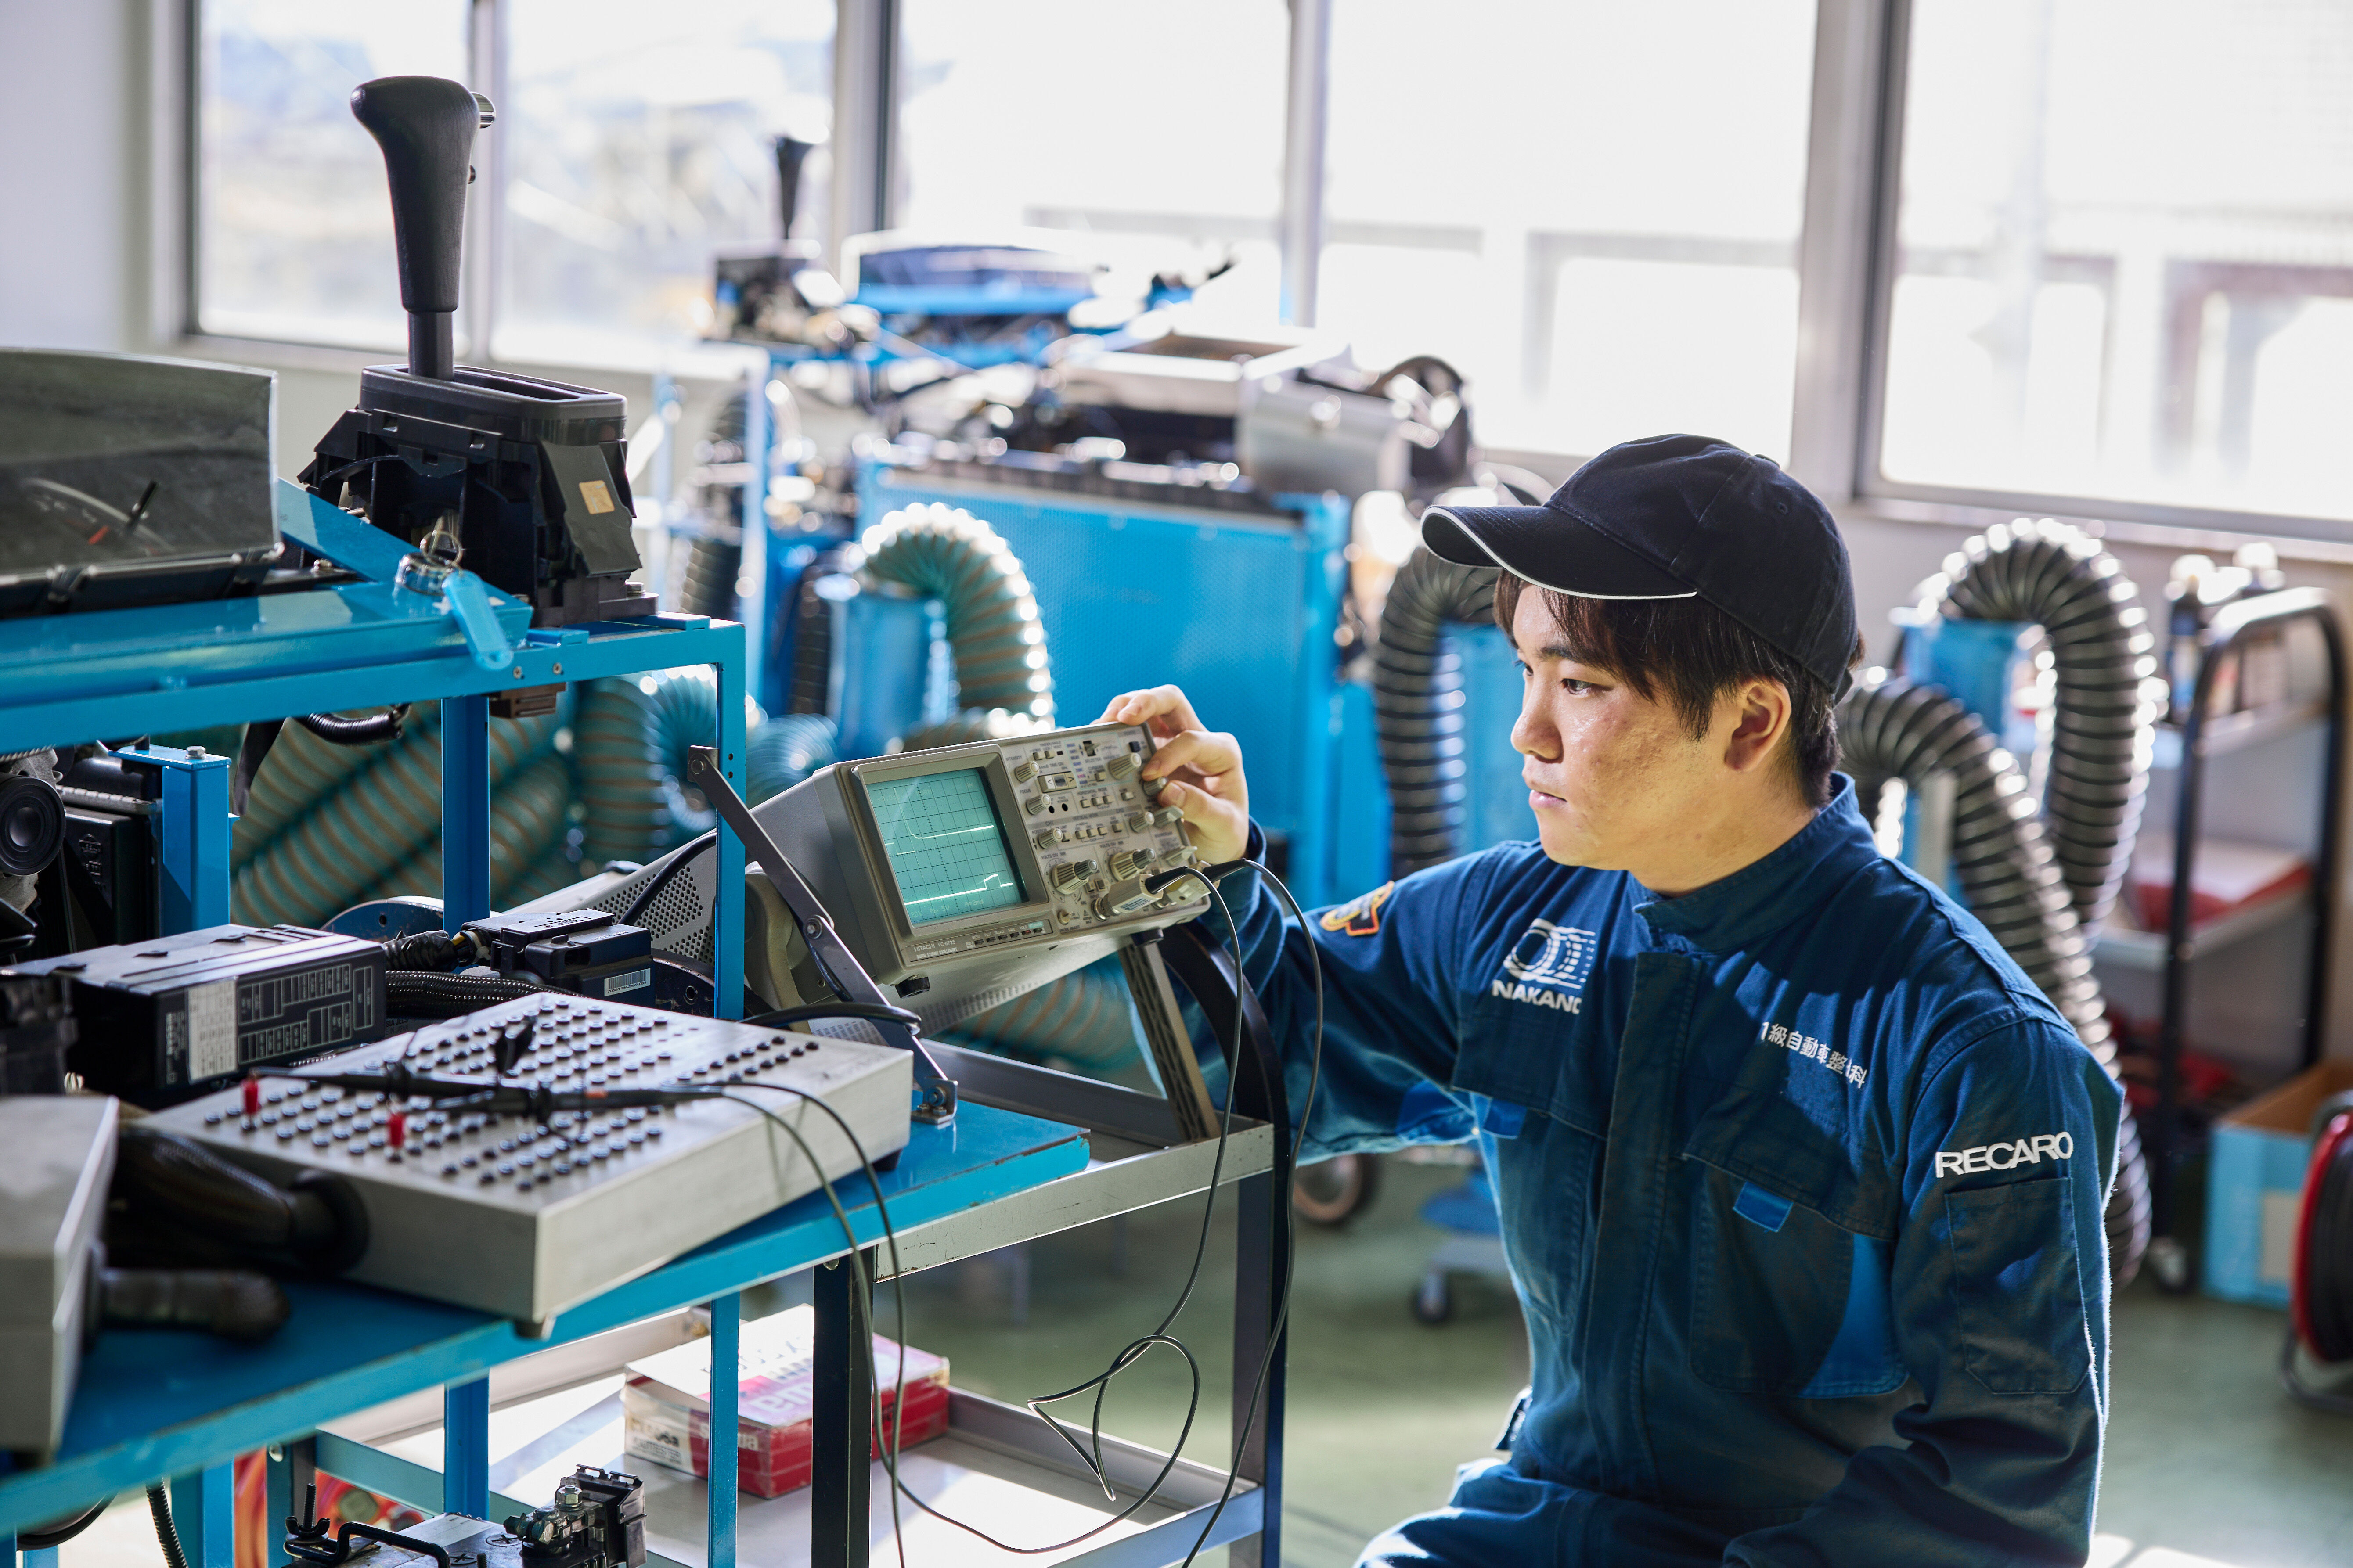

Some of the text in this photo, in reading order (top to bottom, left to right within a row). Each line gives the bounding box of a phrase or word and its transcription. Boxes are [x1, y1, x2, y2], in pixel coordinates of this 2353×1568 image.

[914, 943, 935, 952] HITACHI
[939, 947, 958, 956] OSCILLOSCOPE
[1760, 1021, 1867, 1089] 1級自動車整科
[1935, 1131, 2074, 1178] RECARO
